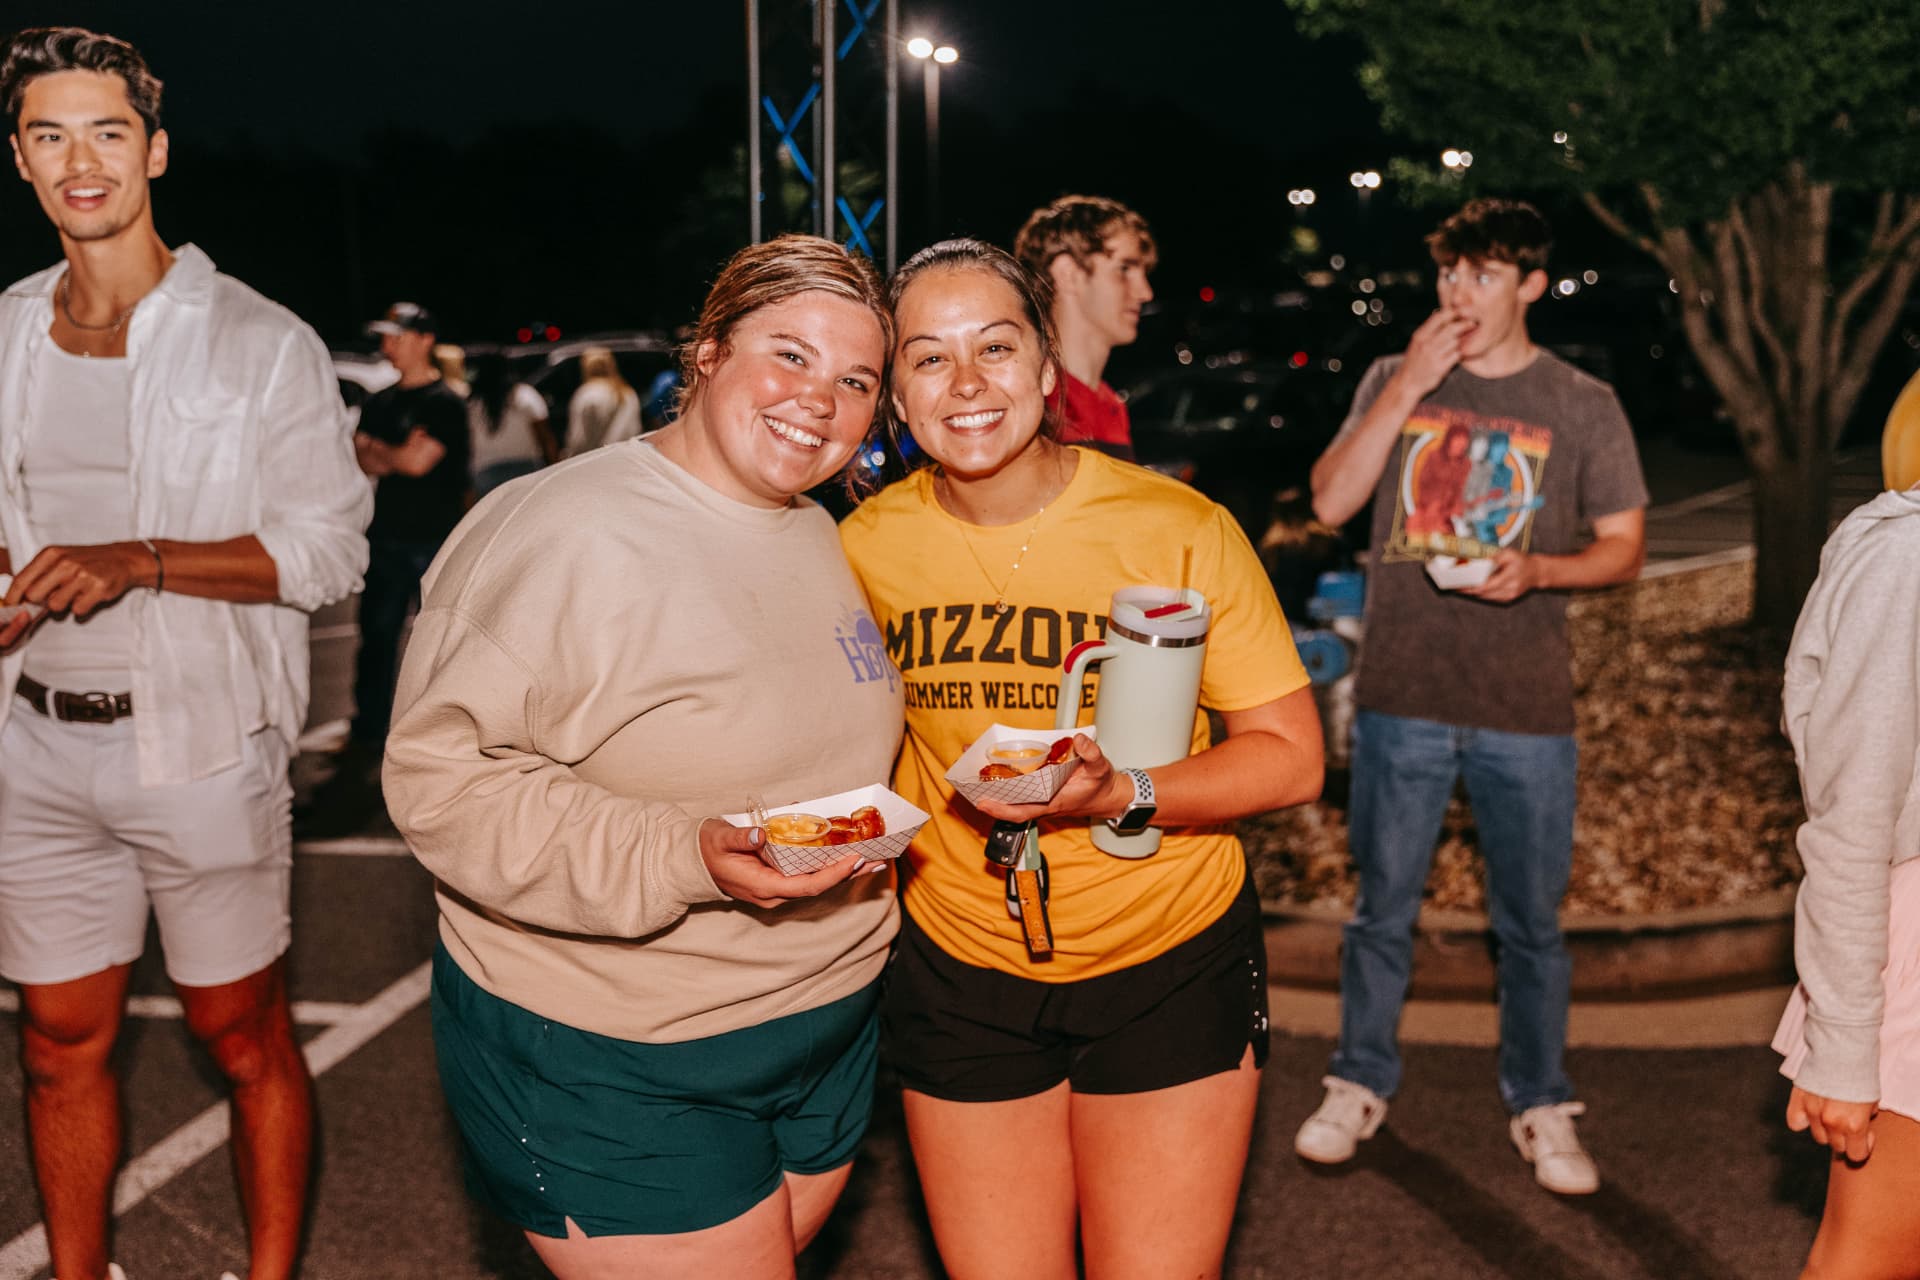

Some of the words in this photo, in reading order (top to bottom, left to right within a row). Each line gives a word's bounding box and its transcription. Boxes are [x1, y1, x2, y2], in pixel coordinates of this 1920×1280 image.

[835, 636, 901, 694] Hop
[904, 681, 974, 710] UMMER
[981, 681, 1095, 710] WELCOE
